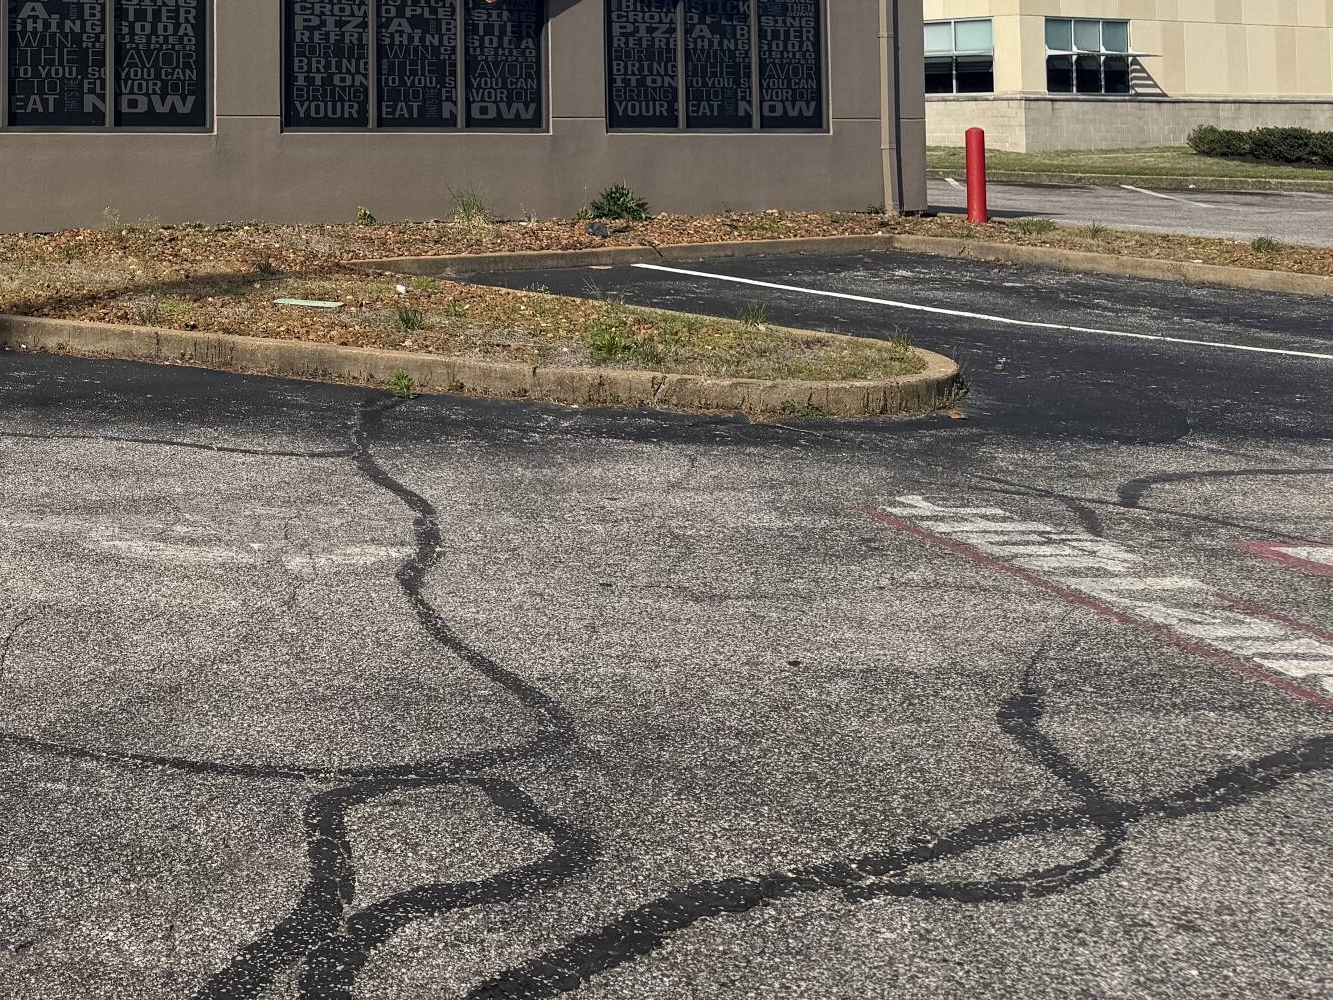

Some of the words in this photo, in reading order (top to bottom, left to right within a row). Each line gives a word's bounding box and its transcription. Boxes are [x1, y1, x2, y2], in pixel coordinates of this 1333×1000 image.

[83, 3, 196, 23] BTTER
[405, 6, 536, 22] PLESING
[706, 14, 815, 28] PLESING
[295, 14, 422, 34] PIZA.
[442, 19, 535, 38] BTTER
[17, 31, 77, 48] WIN.
[736, 25, 814, 41] BTTER
[20, 47, 78, 67] THE
[89, 48, 196, 69] FAVOR
[294, 42, 333, 58] FOR
[339, 43, 369, 58] TH
[386, 44, 435, 60] WIN.
[440, 46, 536, 57] CUSHED
[612, 47, 646, 61] FOR
[650, 48, 676, 62] TH
[690, 48, 732, 63] WIN.
[736, 50, 815, 59] CUSHED
[38, 65, 82, 81] YOU,
[161, 68, 197, 81] CAN
[294, 57, 368, 74] BRING
[389, 58, 438, 76] THE
[446, 60, 536, 79] FAVOR
[612, 60, 677, 75] BRING
[693, 61, 735, 78] THE
[740, 62, 815, 80] FAVOR
[28, 78, 60, 94] TO
[83, 79, 162, 95] FLVOR
[168, 80, 196, 95] OF
[294, 72, 327, 86] IT
[378, 75, 399, 87] TO
[404, 75, 440, 89] YOU,
[469, 75, 502, 89] YOU
[507, 78, 537, 89] CAN
[612, 75, 641, 87] IT
[646, 75, 677, 88] ON
[762, 78, 787, 89] YOU
[792, 78, 816, 89] CAN
[294, 86, 364, 101] BRING
[514, 89, 538, 102] OF
[613, 87, 672, 101] BRING
[738, 88, 792, 101] FLVOR
[797, 88, 816, 101] OF
[83, 94, 196, 114] NOW
[294, 101, 358, 118] YOUR
[367, 101, 423, 118] EAT
[442, 101, 537, 119] NOW
[613, 101, 668, 117] YOUR
[738, 101, 816, 117] NOW
